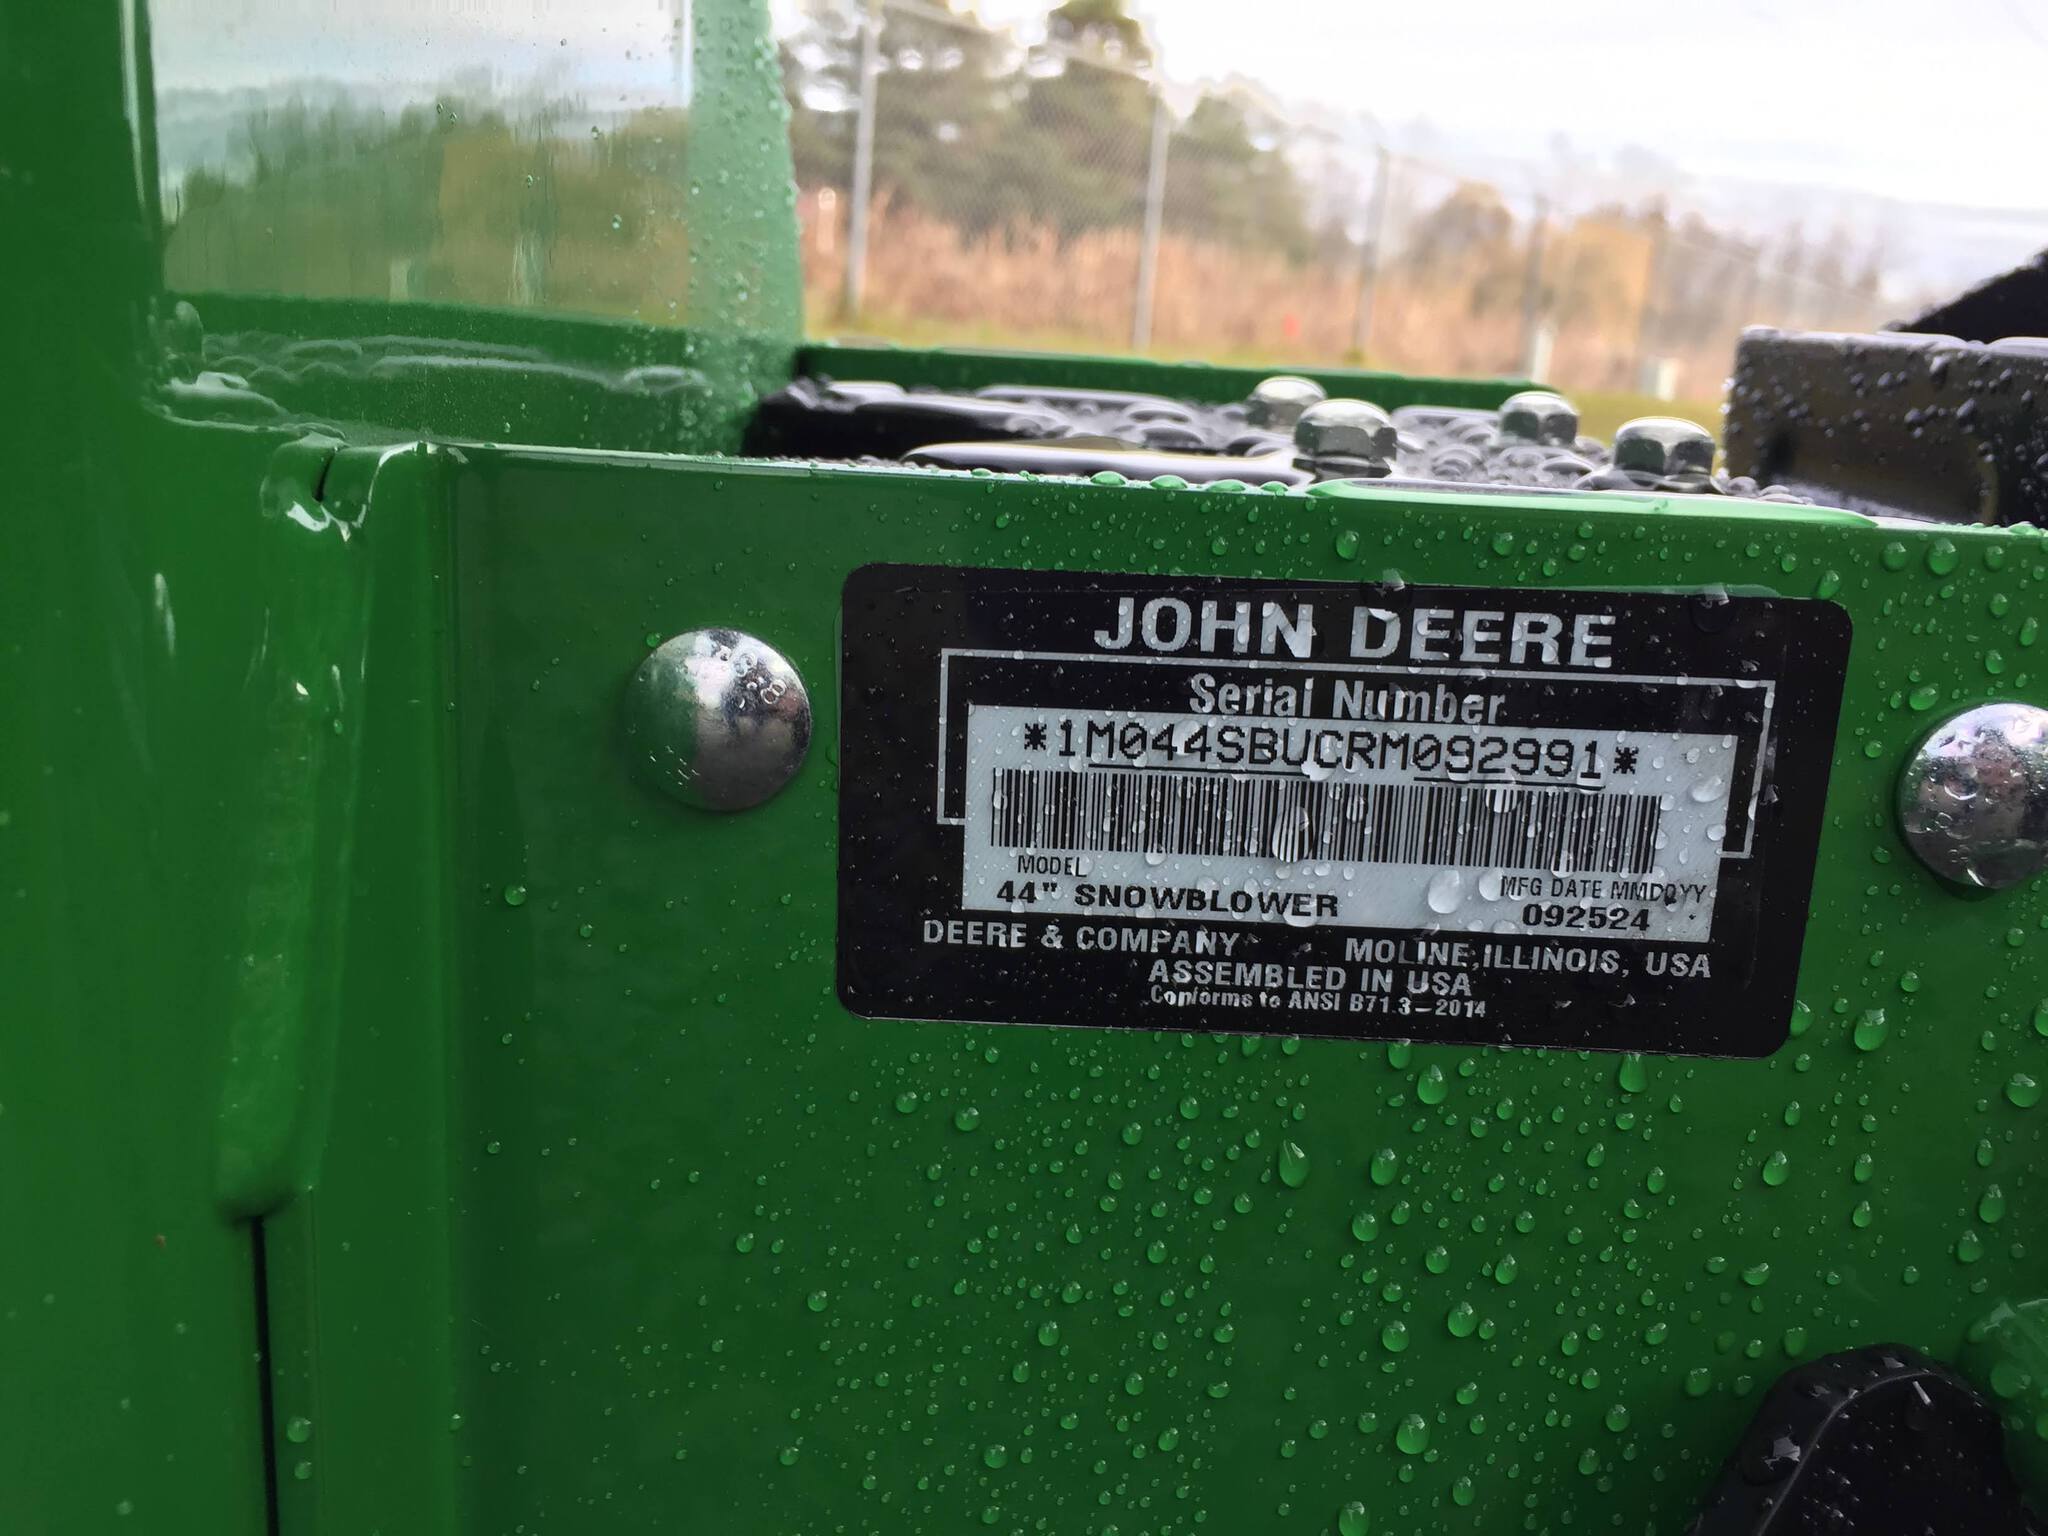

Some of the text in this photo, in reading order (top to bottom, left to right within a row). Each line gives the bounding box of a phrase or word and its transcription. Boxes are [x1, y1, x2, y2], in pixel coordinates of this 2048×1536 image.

[1094, 597, 1616, 668] JOHN DEERE
[1190, 673, 1506, 724] Serial Number
[1018, 854, 1088, 878] MODEL
[997, 880, 1339, 917] 44" SNOWBLOWER
[1500, 876, 1543, 897] MFG
[1551, 879, 1603, 899] DATE
[1522, 903, 1650, 931] 092524
[923, 919, 1241, 957] DEERE & COMPANY
[1148, 959, 1472, 997] ASSEMBLED IN USA
[1645, 951, 1712, 979] USA
[1151, 984, 1253, 1008] Conforms
[1259, 990, 1281, 1008] to
[1288, 990, 1341, 1012] ANSI
